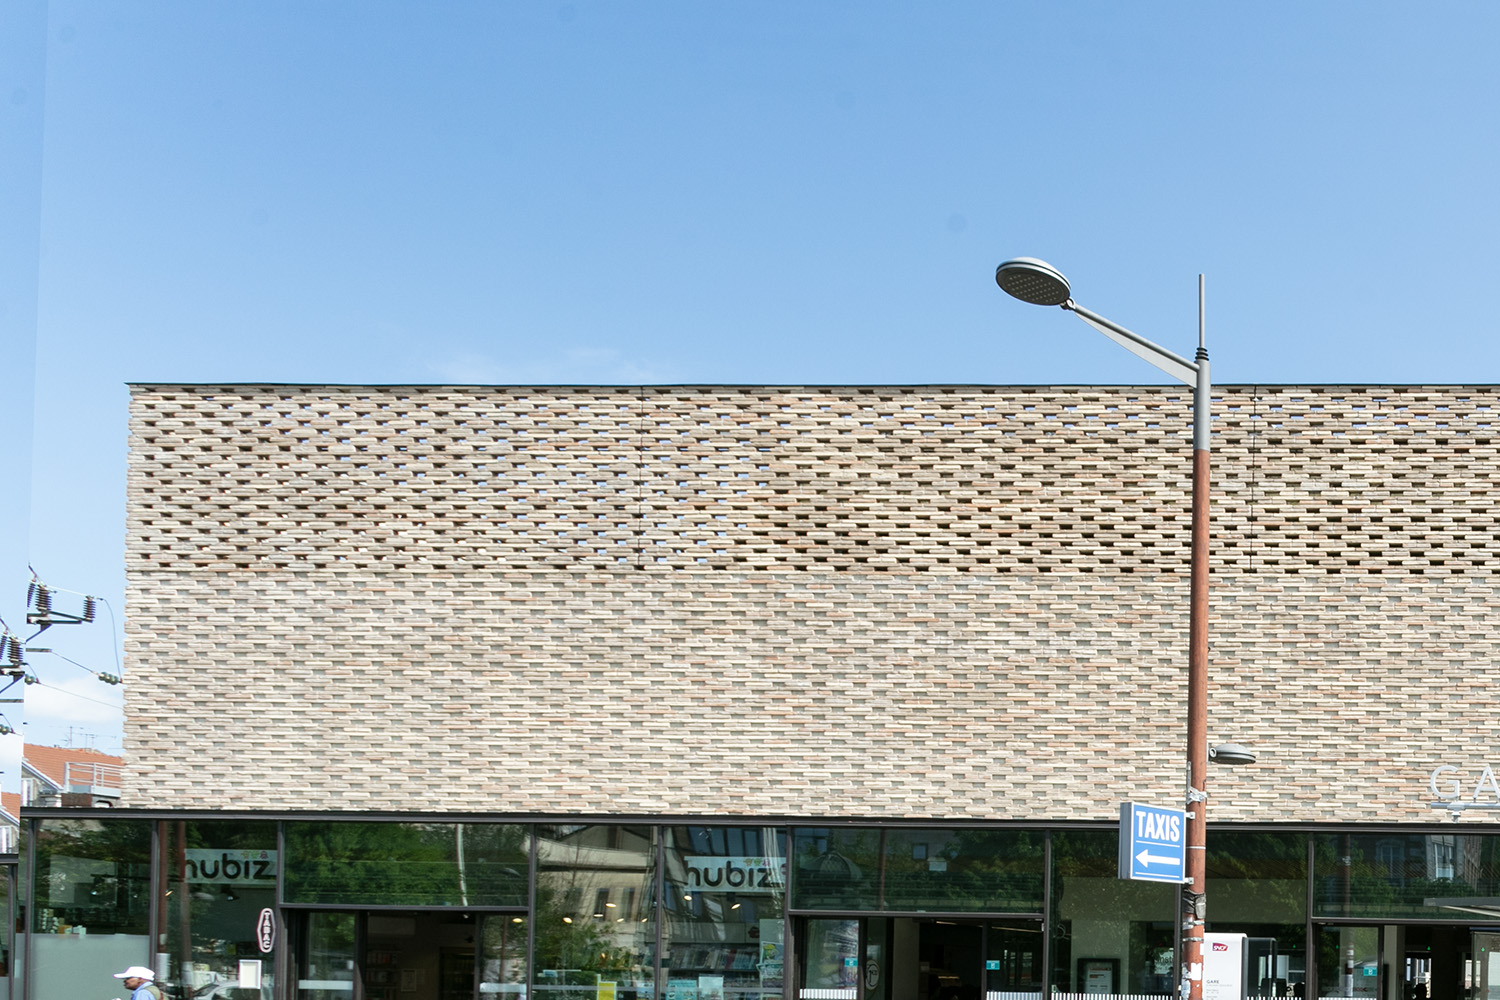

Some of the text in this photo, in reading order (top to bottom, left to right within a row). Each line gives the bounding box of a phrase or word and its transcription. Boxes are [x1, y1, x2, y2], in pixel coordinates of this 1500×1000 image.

[1135, 810, 1180, 842] TAXIS
[685, 860, 785, 887] hubiz
[262, 911, 271, 949] TABAC
